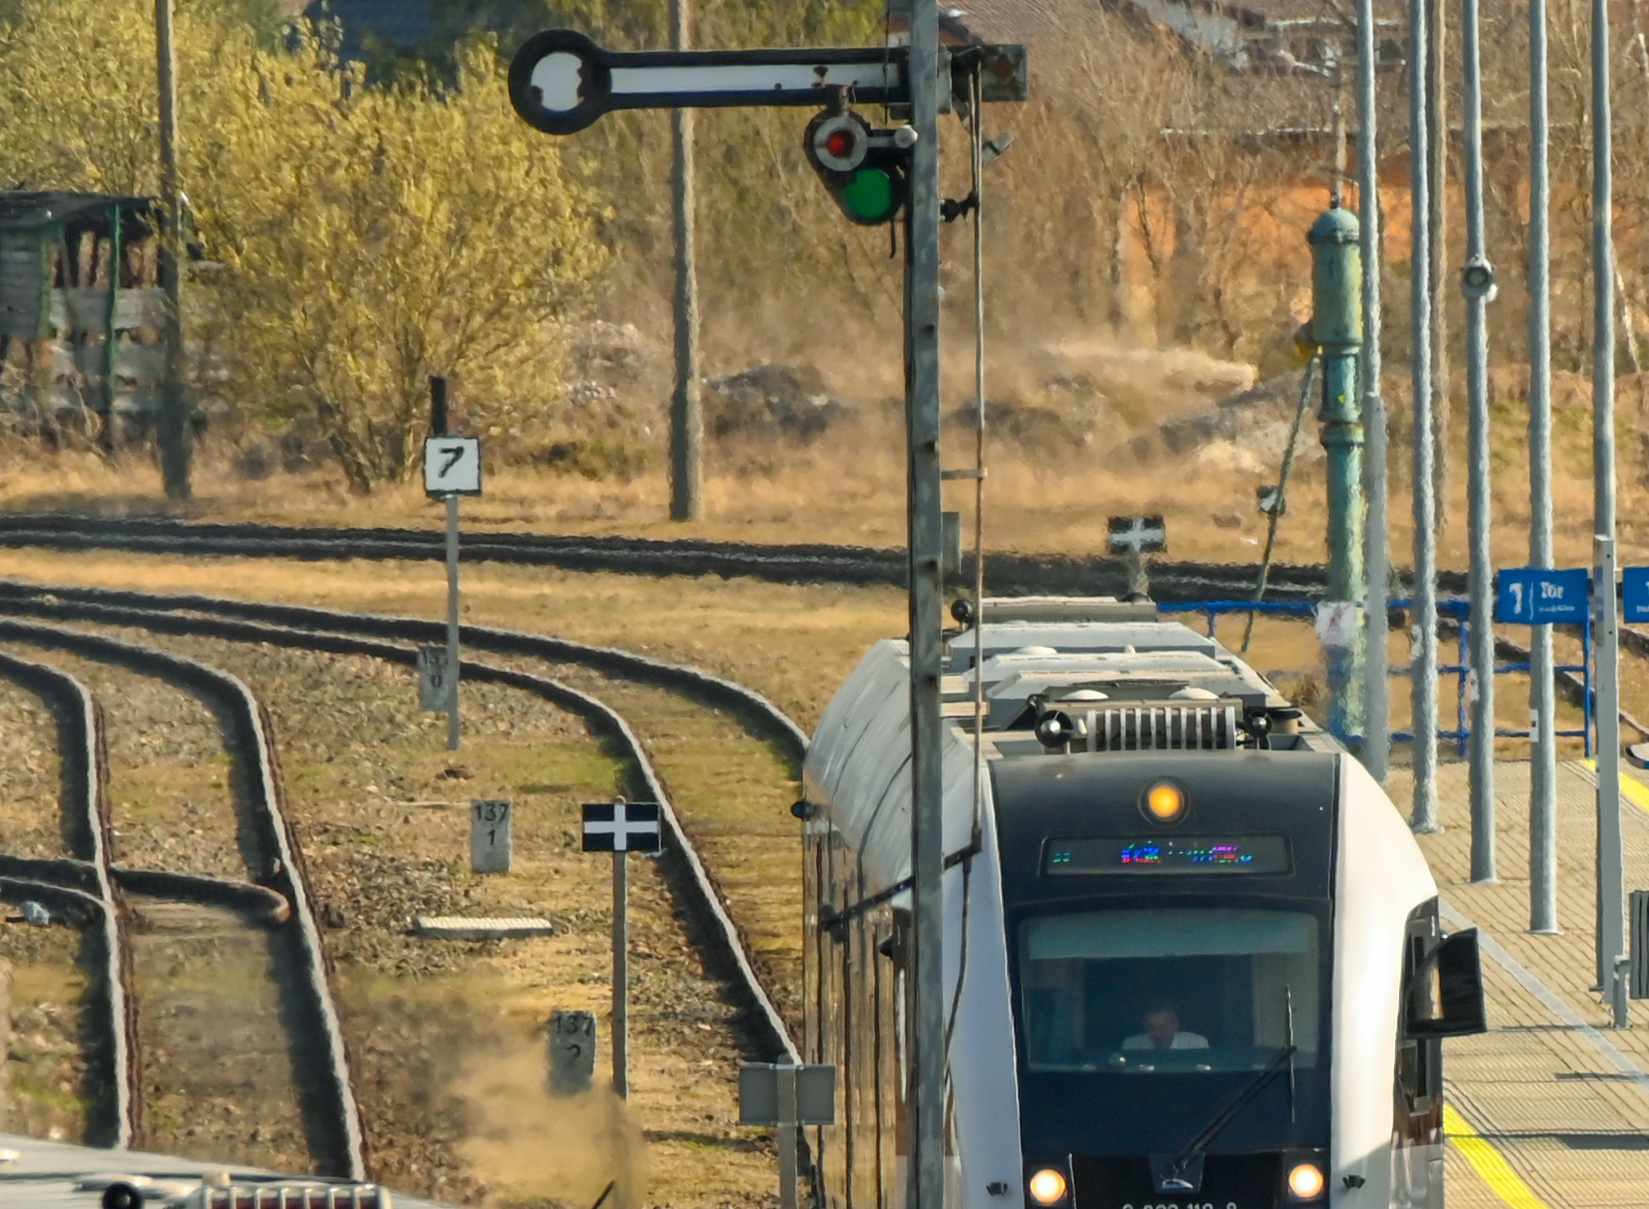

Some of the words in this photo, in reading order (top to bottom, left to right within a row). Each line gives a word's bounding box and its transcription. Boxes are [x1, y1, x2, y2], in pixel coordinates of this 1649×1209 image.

[439, 446, 464, 478] 7
[1509, 583, 1522, 614] 1
[475, 803, 509, 824] 137
[488, 829, 495, 846] 1
[554, 1014, 594, 1036] 137
